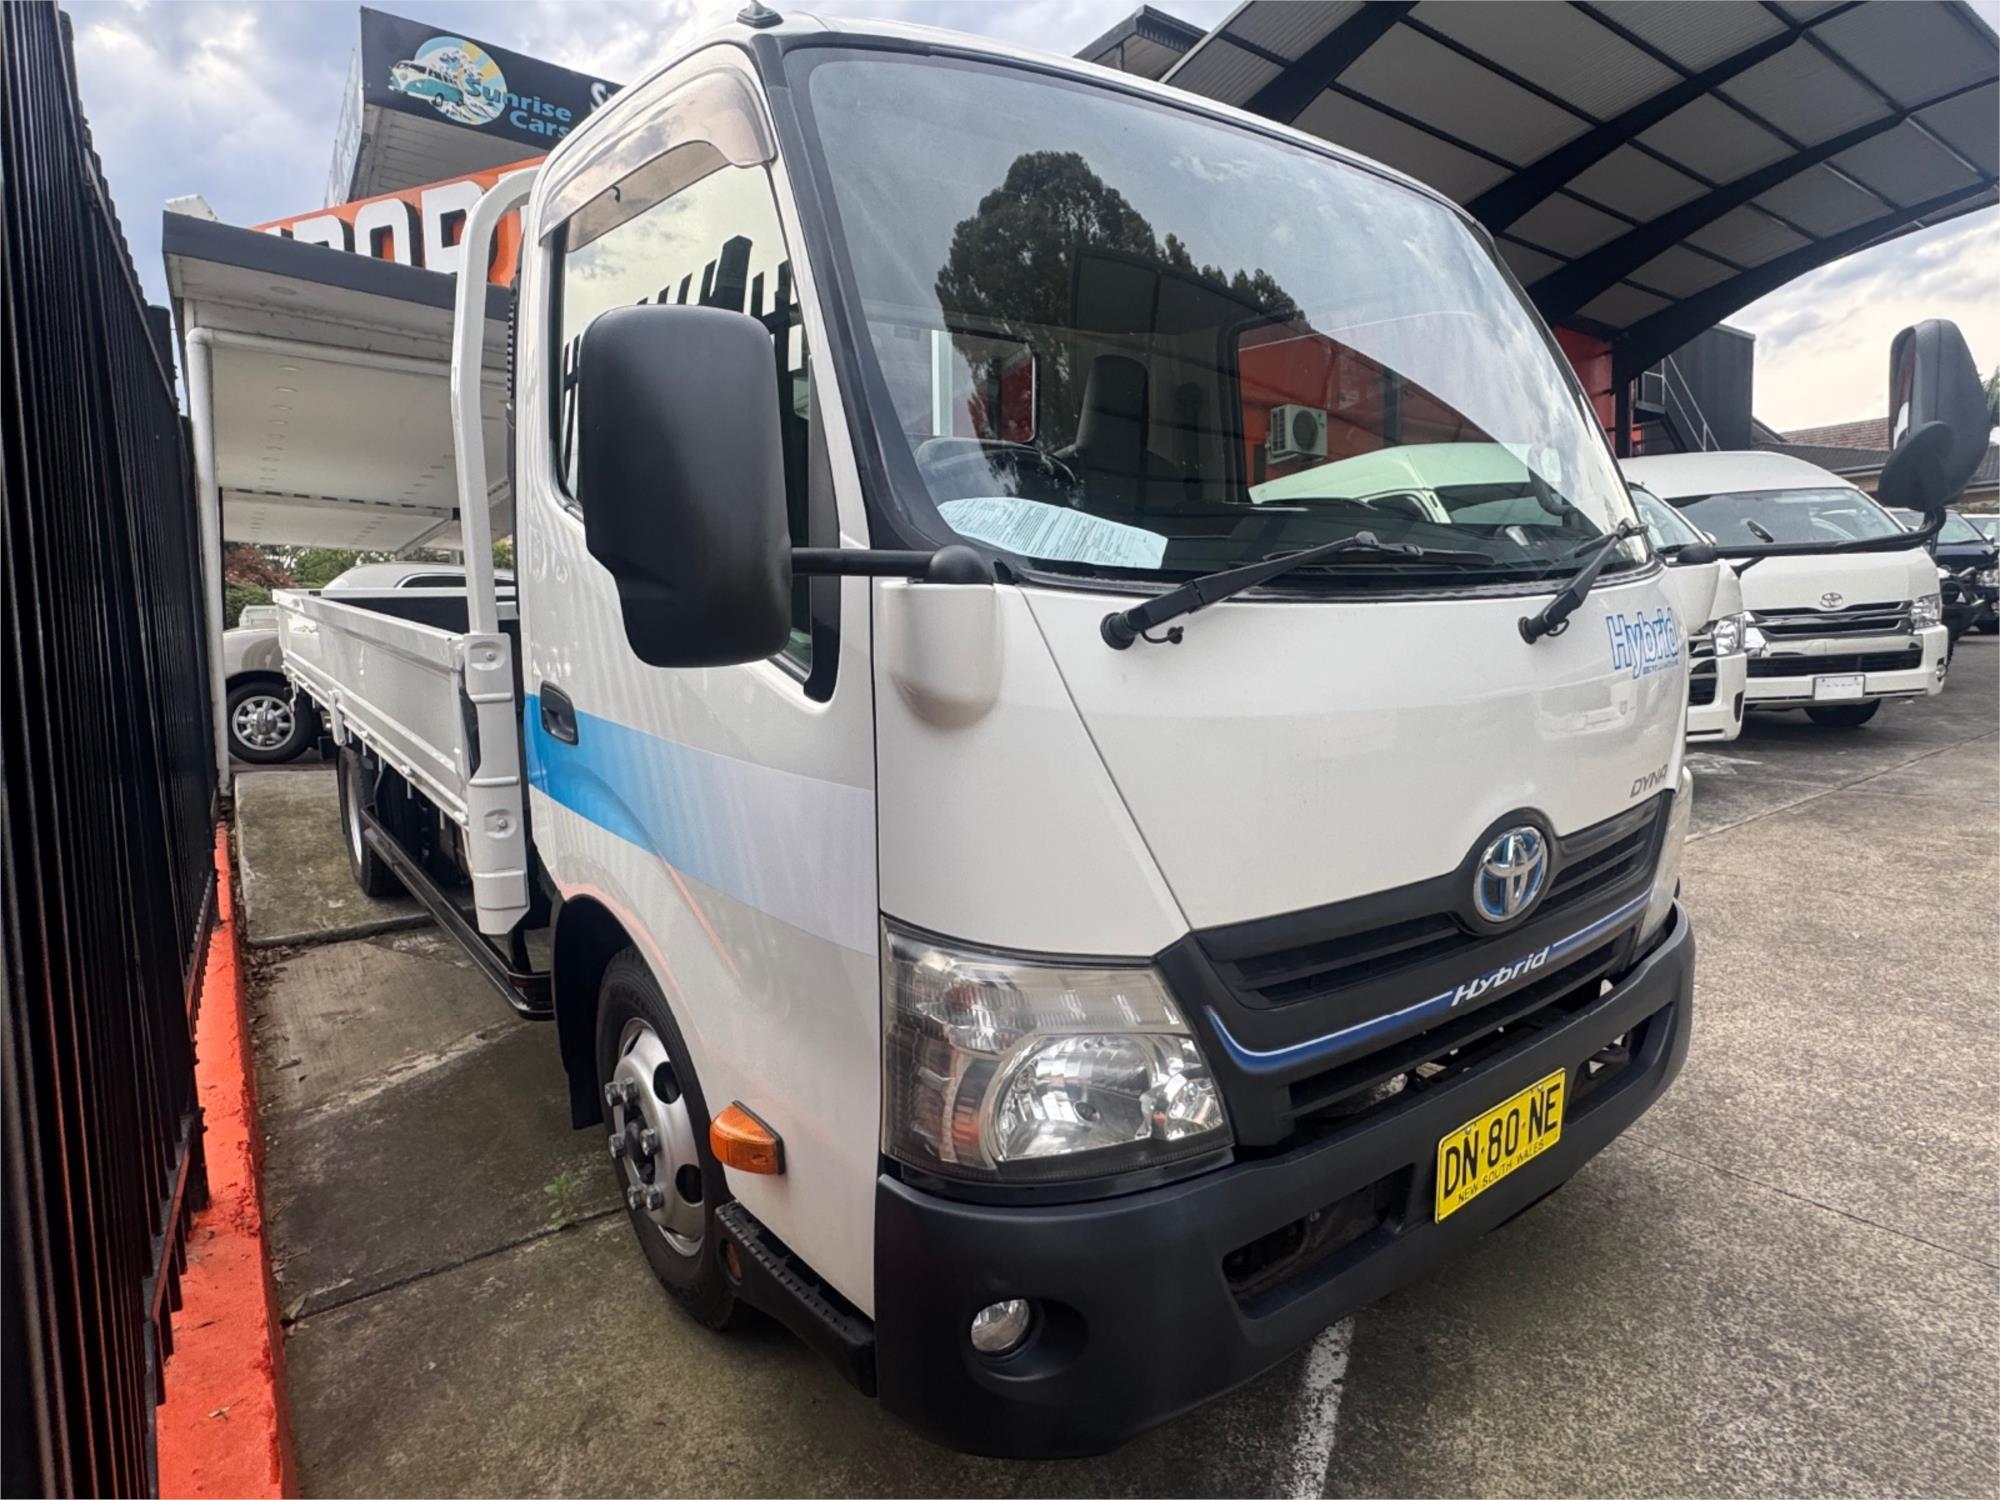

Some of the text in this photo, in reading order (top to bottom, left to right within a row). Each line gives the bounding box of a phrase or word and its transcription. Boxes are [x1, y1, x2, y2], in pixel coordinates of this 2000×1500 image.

[464, 76, 572, 122] Sunrise
[509, 110, 571, 139] Cars
[1606, 607, 1679, 680] Hybrid
[1630, 763, 1668, 798] DYNA
[1451, 945, 1550, 1007] Hybrid
[1458, 1138, 1545, 1202] NEW SOUTH WALES
